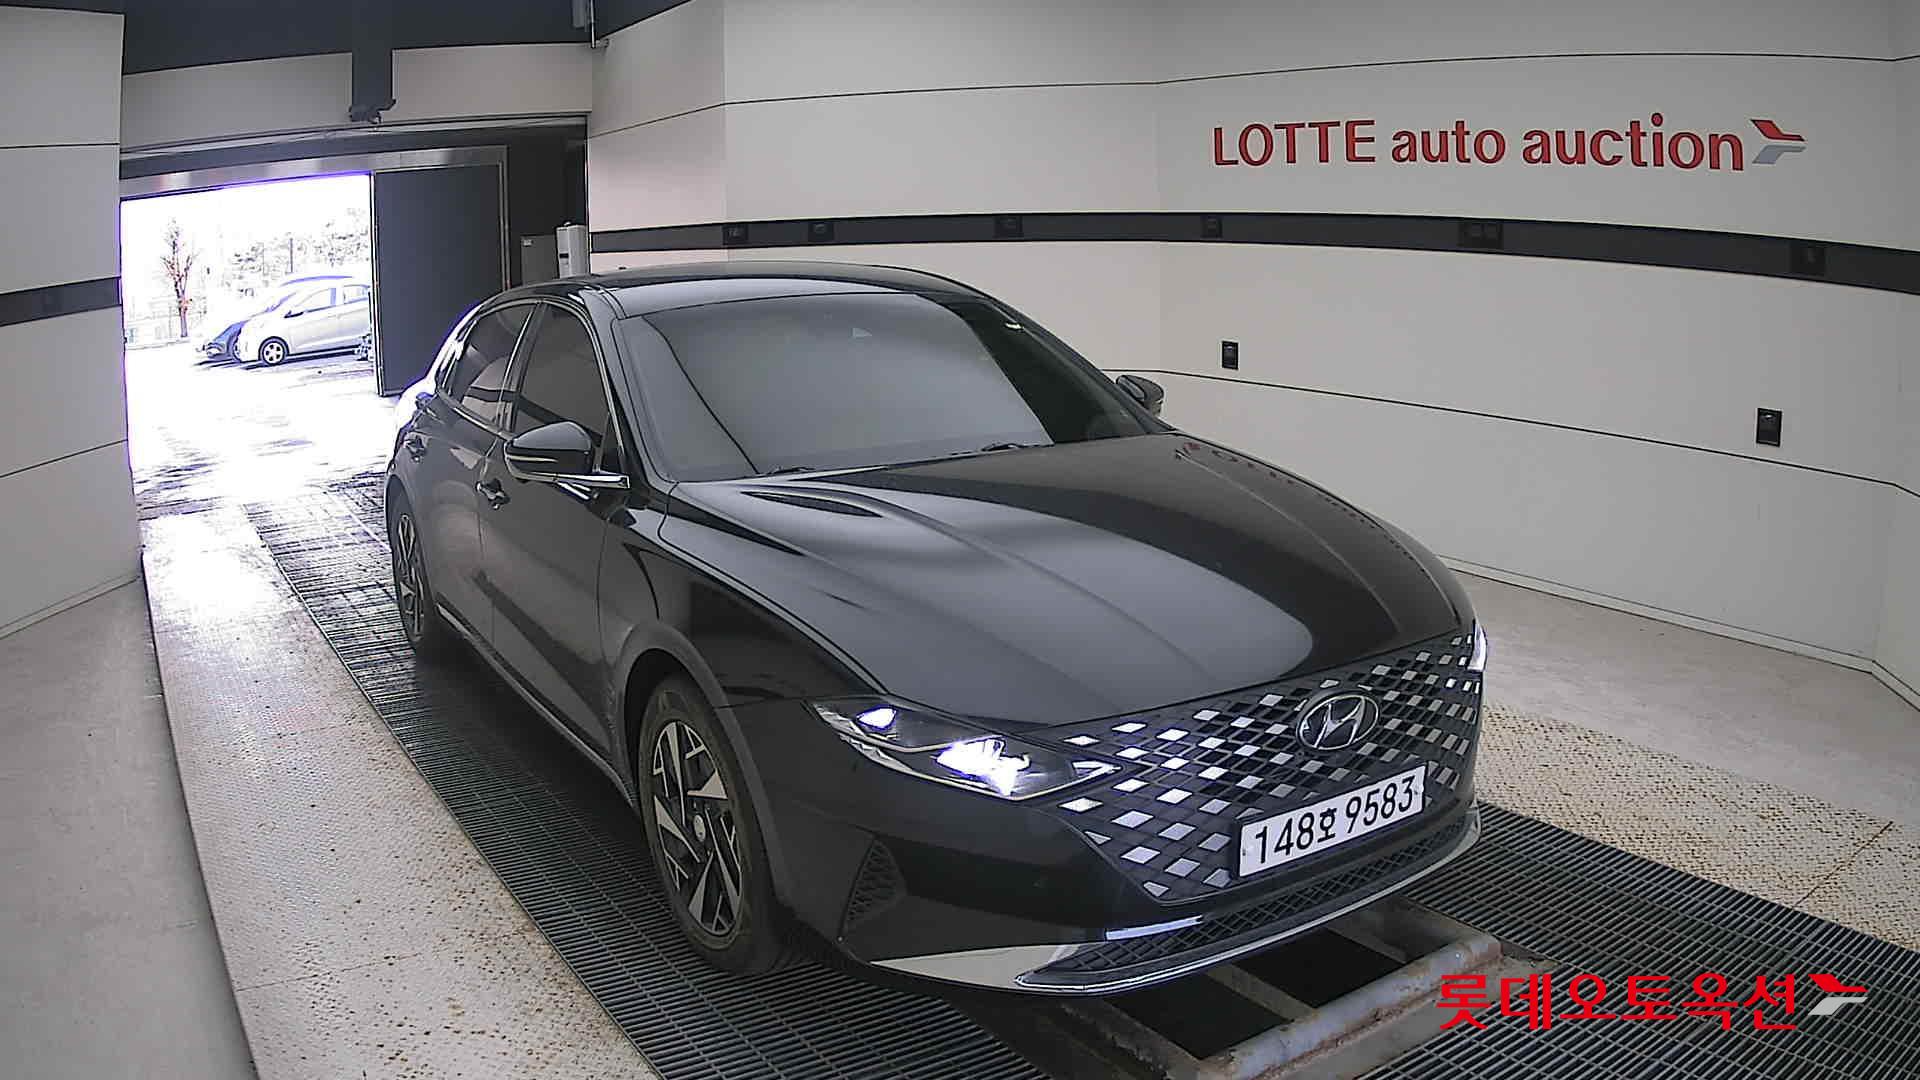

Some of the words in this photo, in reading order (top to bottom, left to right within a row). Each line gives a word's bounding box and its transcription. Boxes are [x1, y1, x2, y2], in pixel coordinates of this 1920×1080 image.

[1213, 120, 1376, 167] LOTTE
[1391, 121, 1506, 165] auto
[1522, 112, 1744, 171] auction
[1255, 807, 1338, 865] 148호
[1345, 775, 1416, 834] 9583
